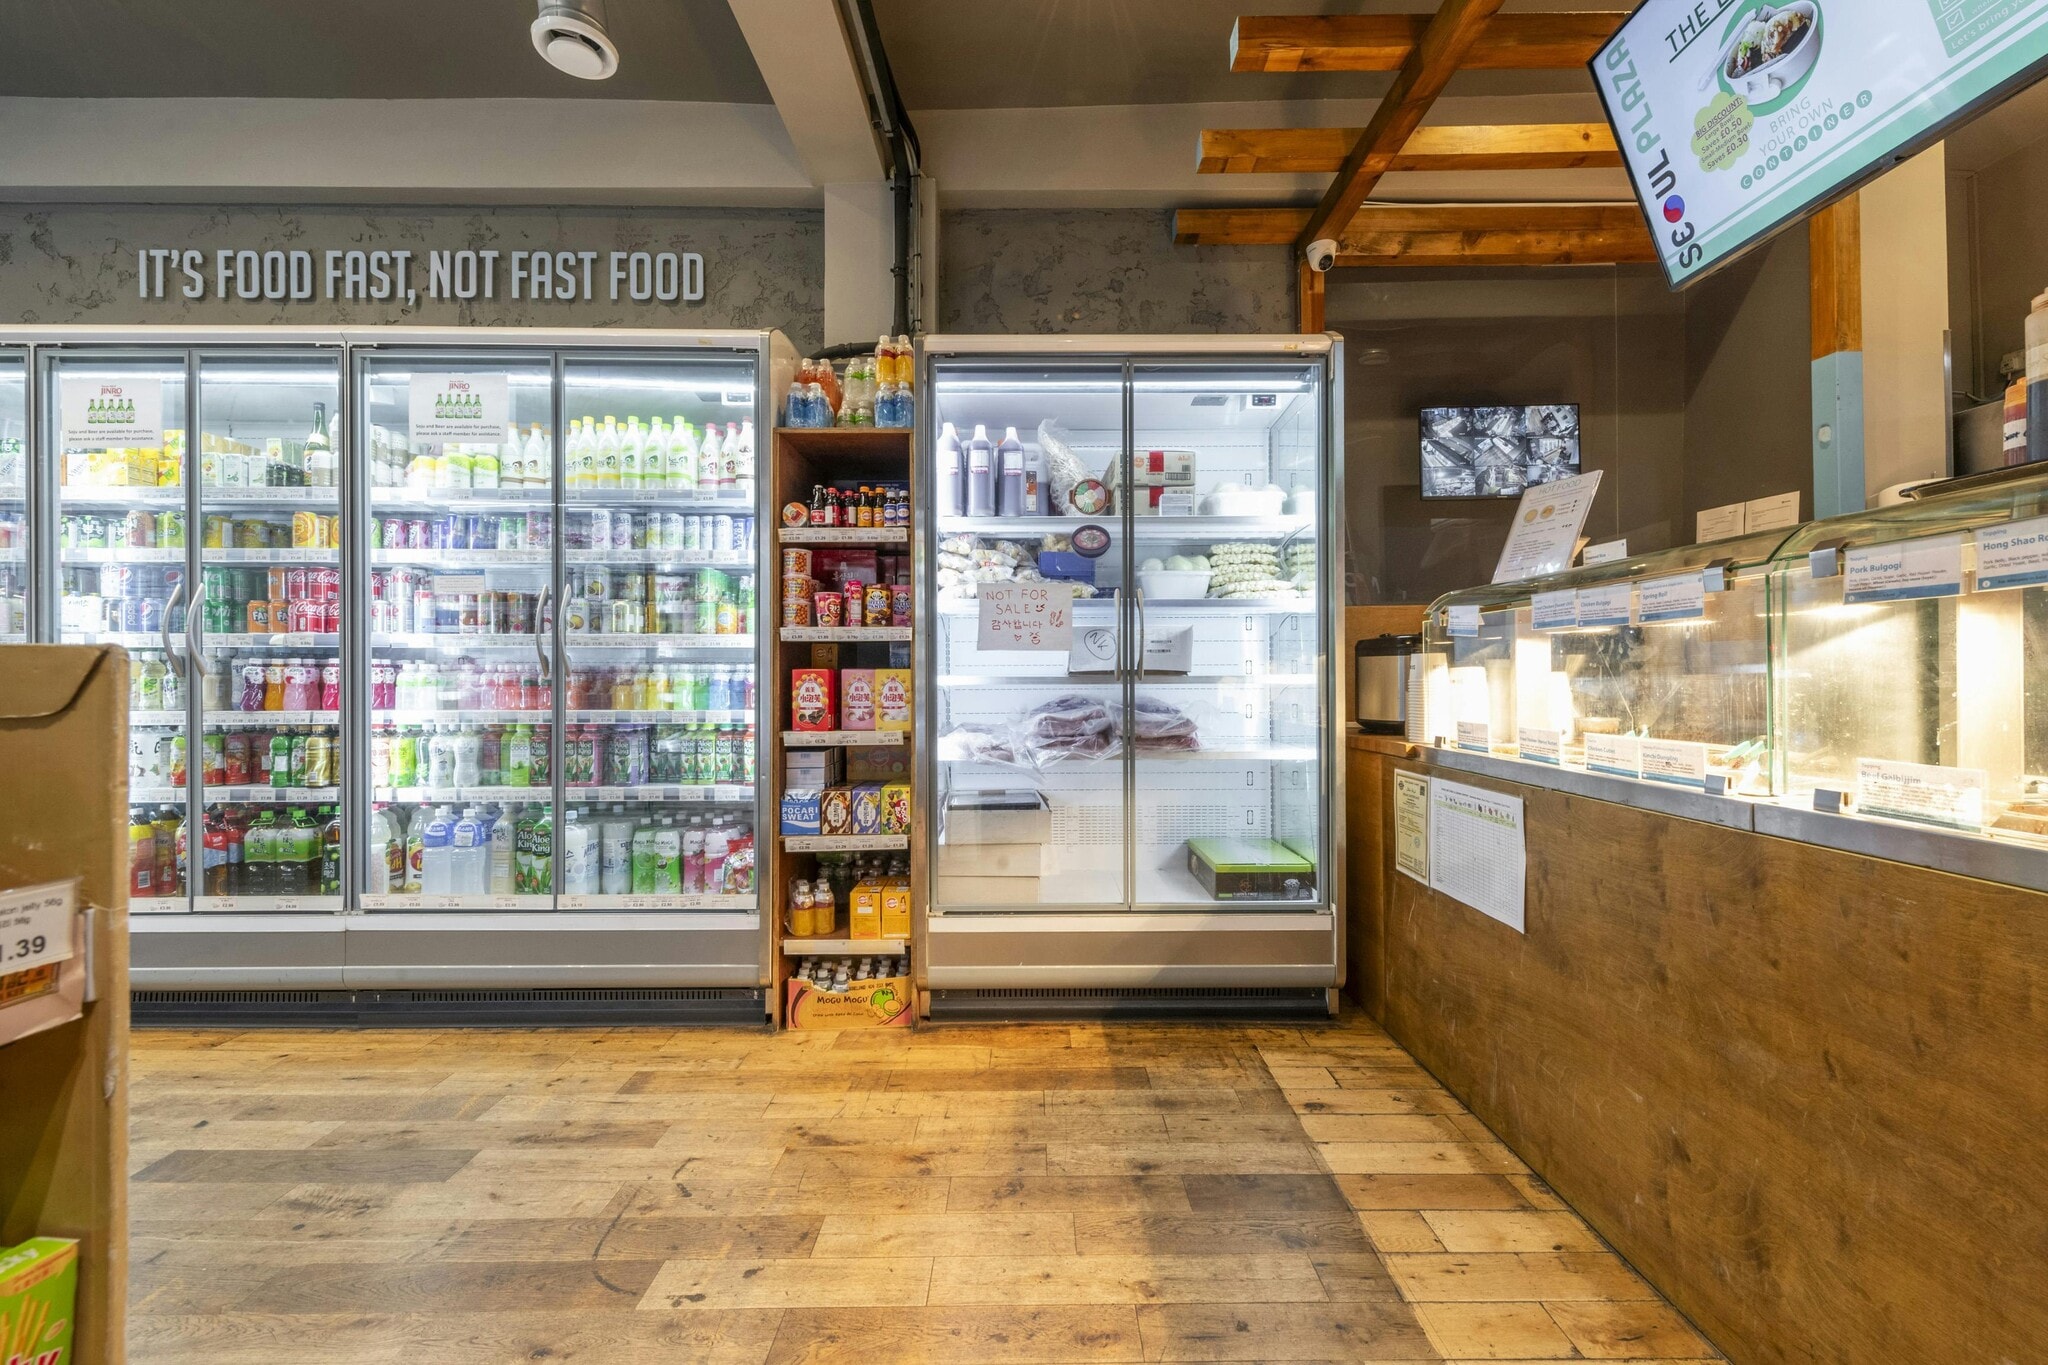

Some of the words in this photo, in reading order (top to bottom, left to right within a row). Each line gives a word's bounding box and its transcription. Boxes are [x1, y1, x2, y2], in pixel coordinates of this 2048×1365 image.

[1665, 1, 1710, 52] THE
[1951, 29, 1976, 49] Let's
[1978, 7, 2009, 31] bring
[1604, 37, 1663, 154] PLAZA
[1769, 96, 1811, 133] BRING
[1695, 125, 1708, 138] BIG
[1704, 125, 1720, 141] Large
[1759, 128, 1796, 157] YOUR
[1799, 98, 1834, 129] OWN
[1701, 135, 1721, 154] Saves
[1720, 117, 1743, 139] £0.50
[1742, 91, 1871, 188] CONTAINER
[1707, 152, 1726, 170] Saves
[1725, 133, 1749, 155] £0.30
[138, 249, 205, 300] IT'S
[217, 249, 312, 301] FOOD
[325, 249, 418, 306] FAST,
[429, 249, 500, 300] NOT
[510, 250, 597, 301] FAST
[609, 251, 706, 303] FOOD
[100, 387, 123, 396] JINRO
[448, 382, 470, 391] JINRO
[1983, 540, 2009, 551] Hong
[2010, 537, 2036, 547] Shao
[1849, 564, 1868, 574] Pork
[1869, 561, 1902, 572] Bulgogi
[986, 589, 1013, 601] NOT
[1021, 588, 1048, 601] FOR
[995, 603, 1031, 615] SALE
[991, 619, 1043, 631] 감사합니다
[782, 806, 818, 814] POCARI
[782, 813, 815, 821] SWEAT
[532, 833, 551, 844] Aloe
[532, 843, 551, 853] King
